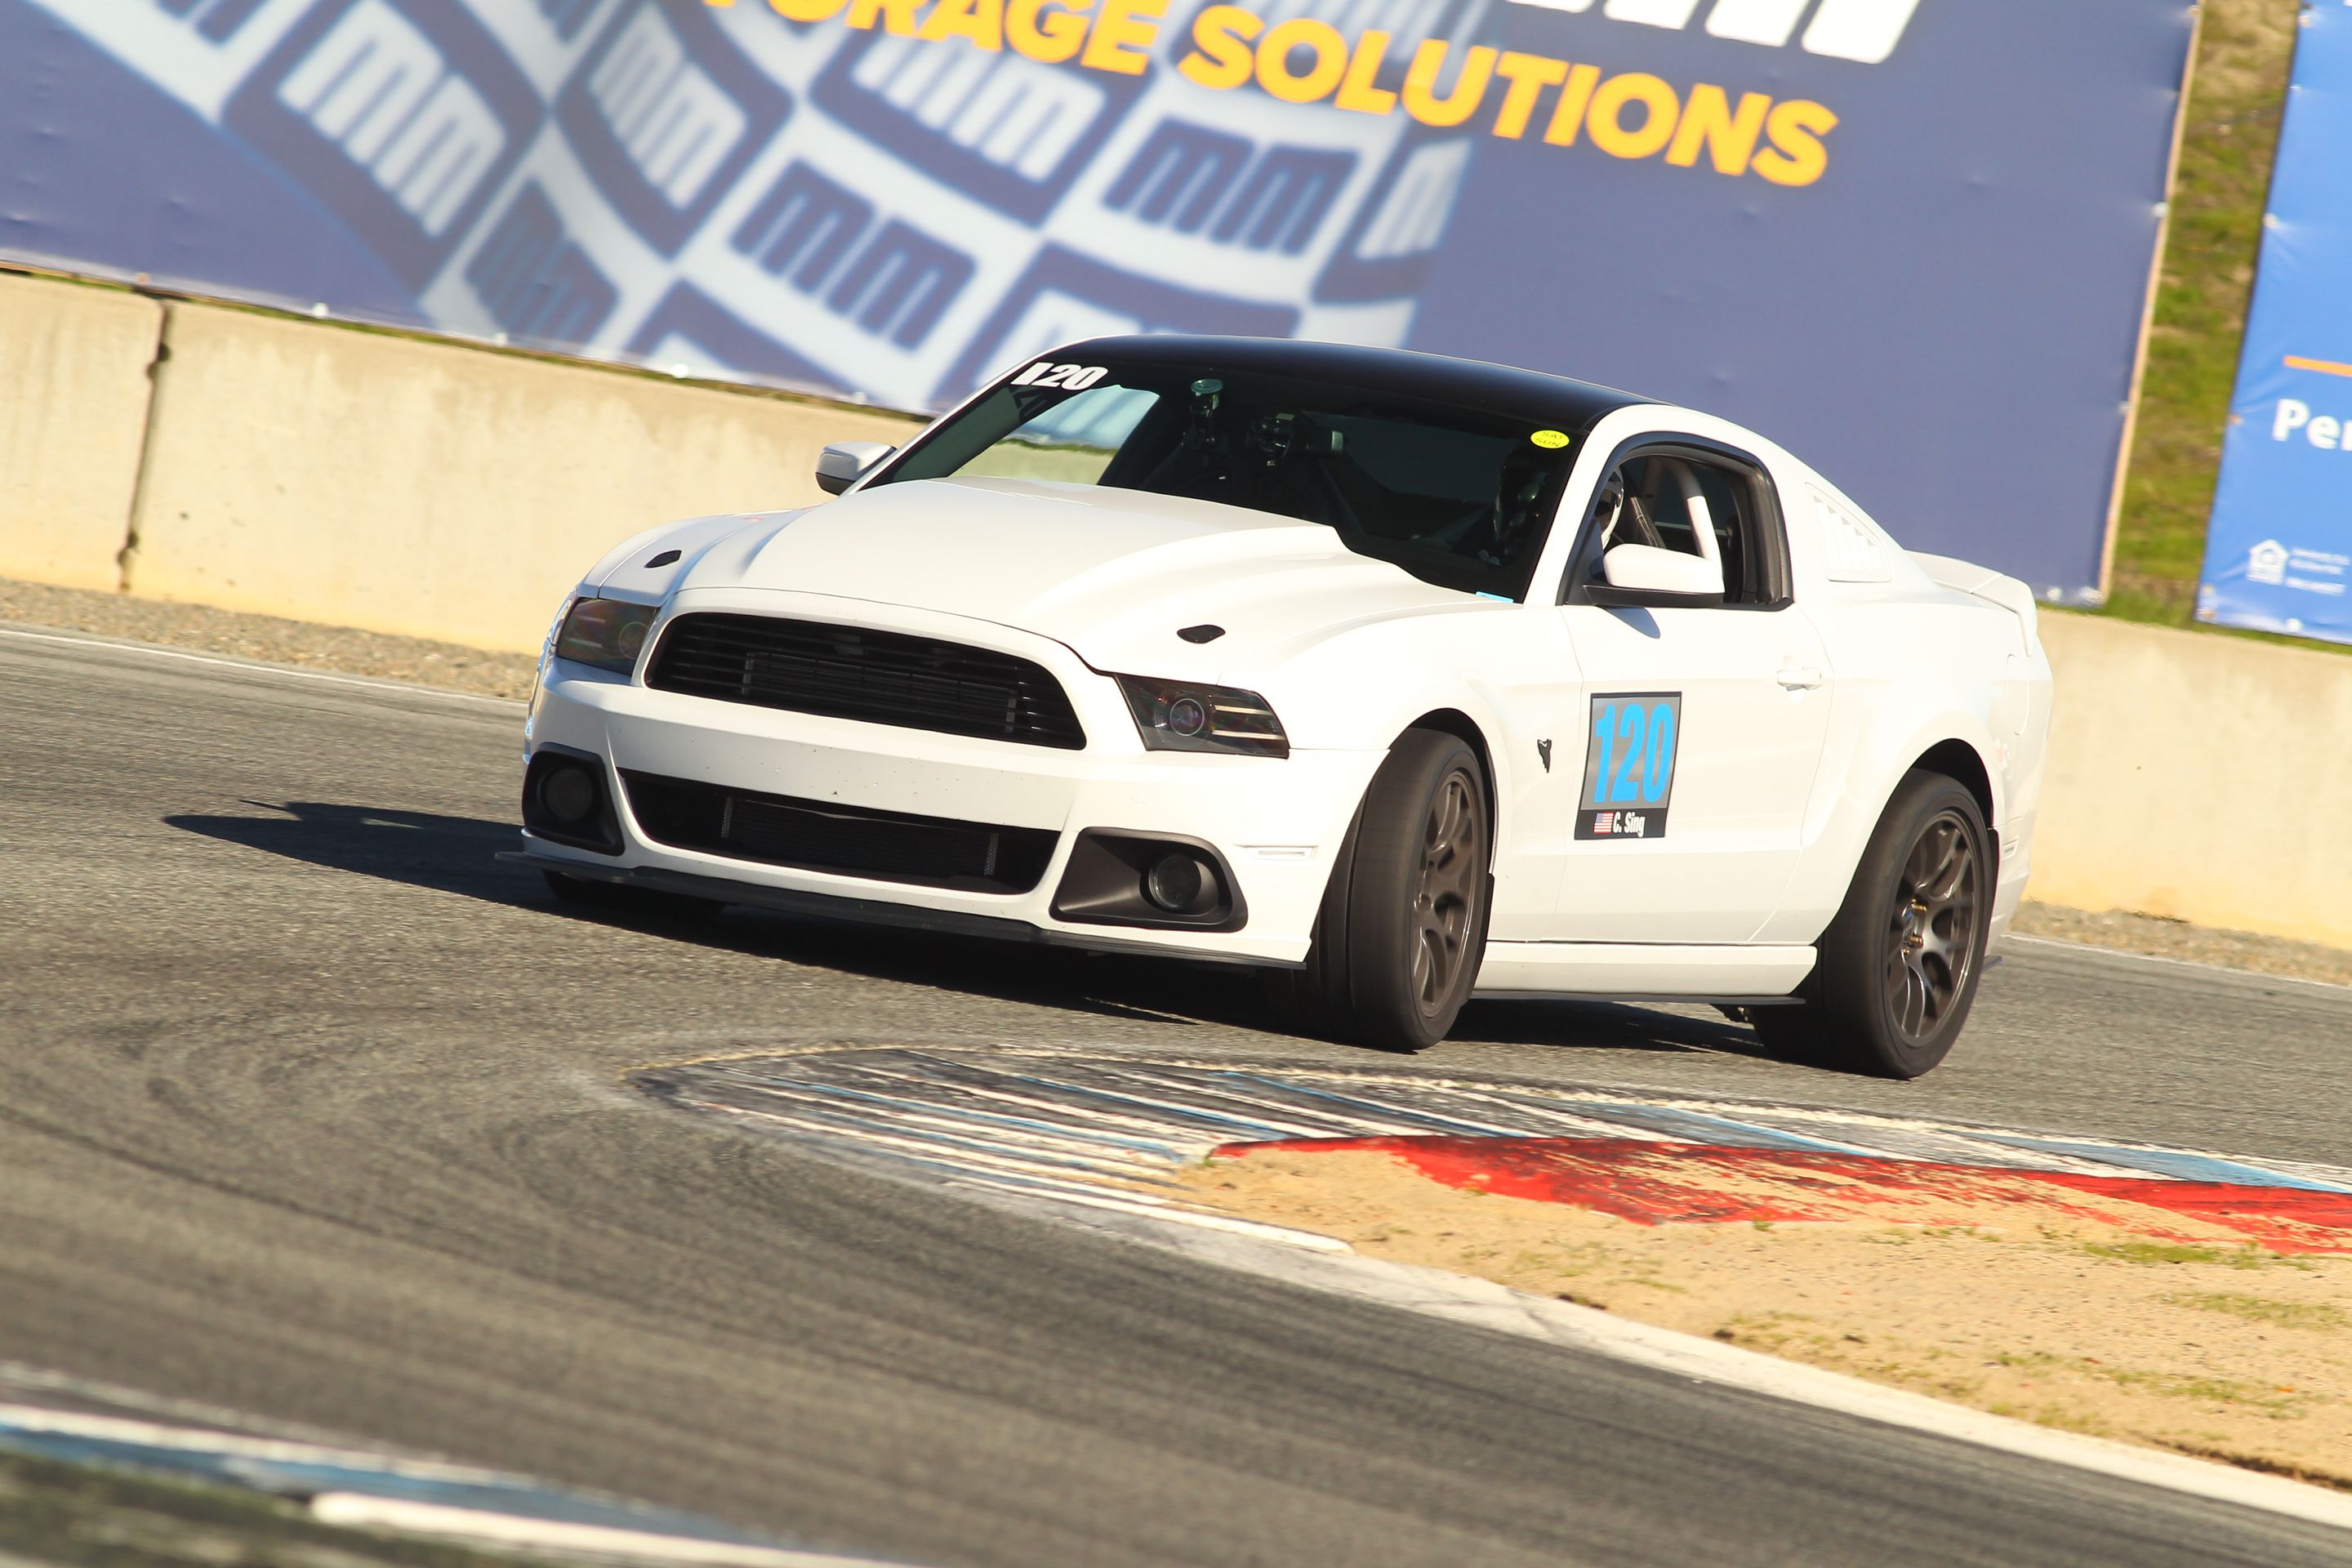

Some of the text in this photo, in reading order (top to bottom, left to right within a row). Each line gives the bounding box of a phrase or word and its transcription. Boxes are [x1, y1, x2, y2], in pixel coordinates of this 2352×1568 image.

[1177, 5, 1839, 186] SOLUTIONS
[1010, 362, 1108, 390] 120
[1535, 438, 1560, 447] SUN
[1595, 703, 1673, 802] 120
[1613, 811, 1646, 838] C. Sing
